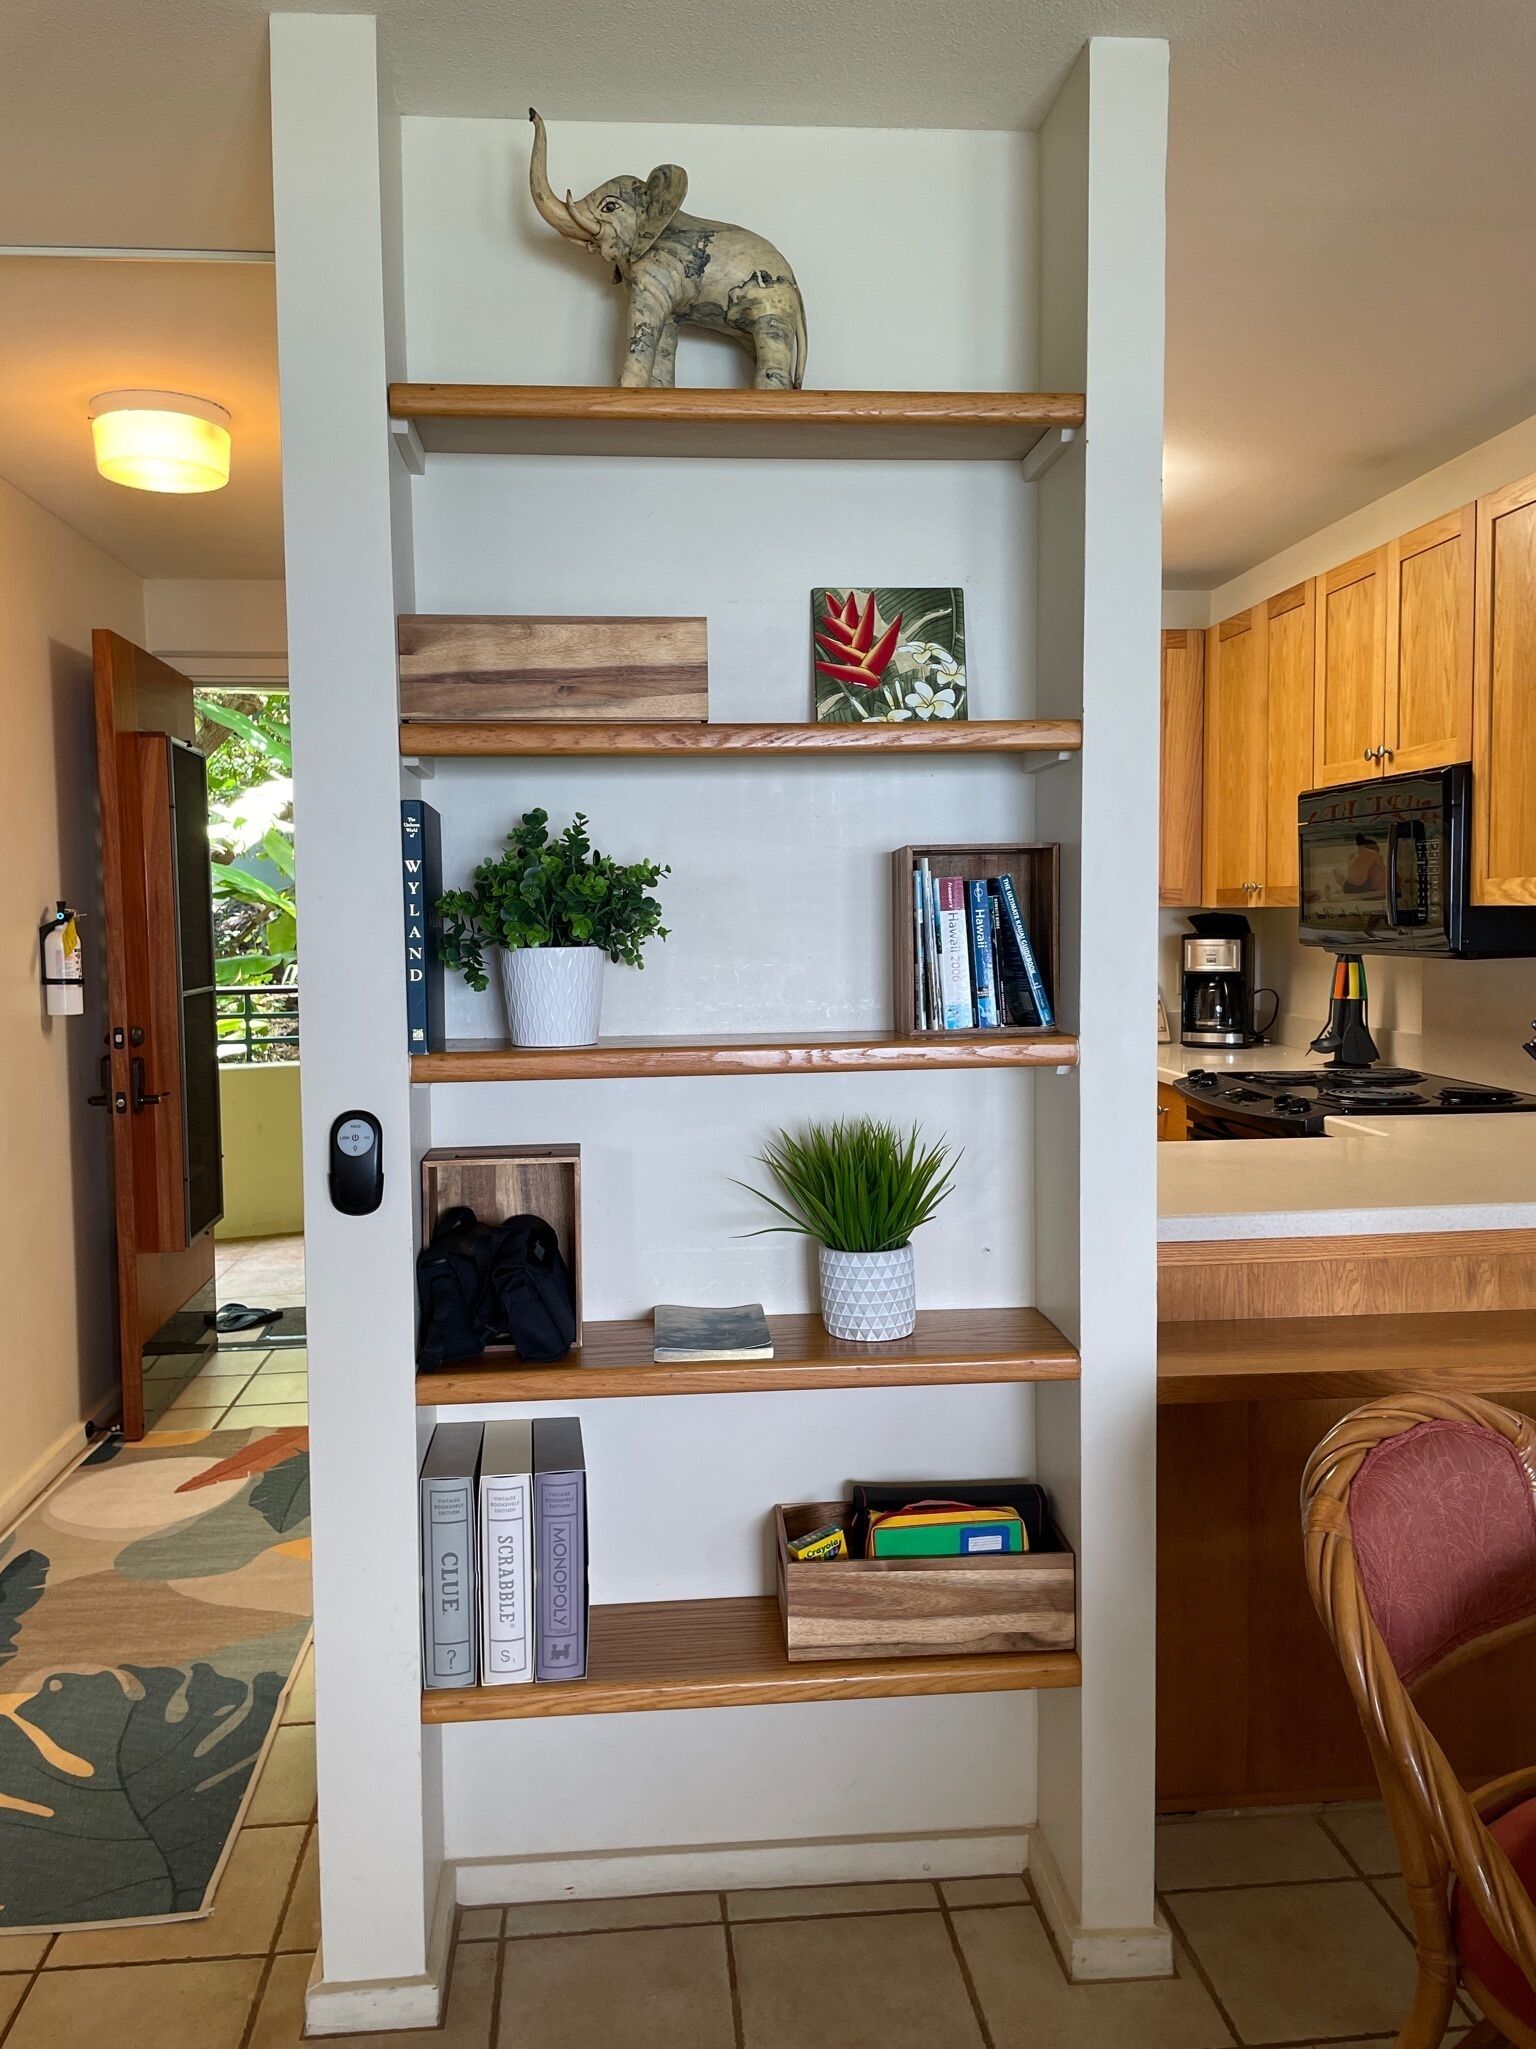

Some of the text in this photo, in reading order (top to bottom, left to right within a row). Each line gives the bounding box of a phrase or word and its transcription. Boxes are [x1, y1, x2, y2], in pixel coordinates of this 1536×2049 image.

[1003, 878, 1011, 890] THE
[1006, 890, 1020, 920] ULTIMATE
[405, 860, 422, 982] WYLAND
[975, 909, 987, 948] Hawaii
[948, 912, 961, 982] Hawaii 2006
[1021, 939, 1036, 974] GUIDEBOOK
[807, 1540, 839, 1558] Crayola
[441, 1552, 459, 1613] CLUE
[498, 1536, 515, 1623] SCRABBLE
[553, 1528, 567, 1626] MONOPOLY
